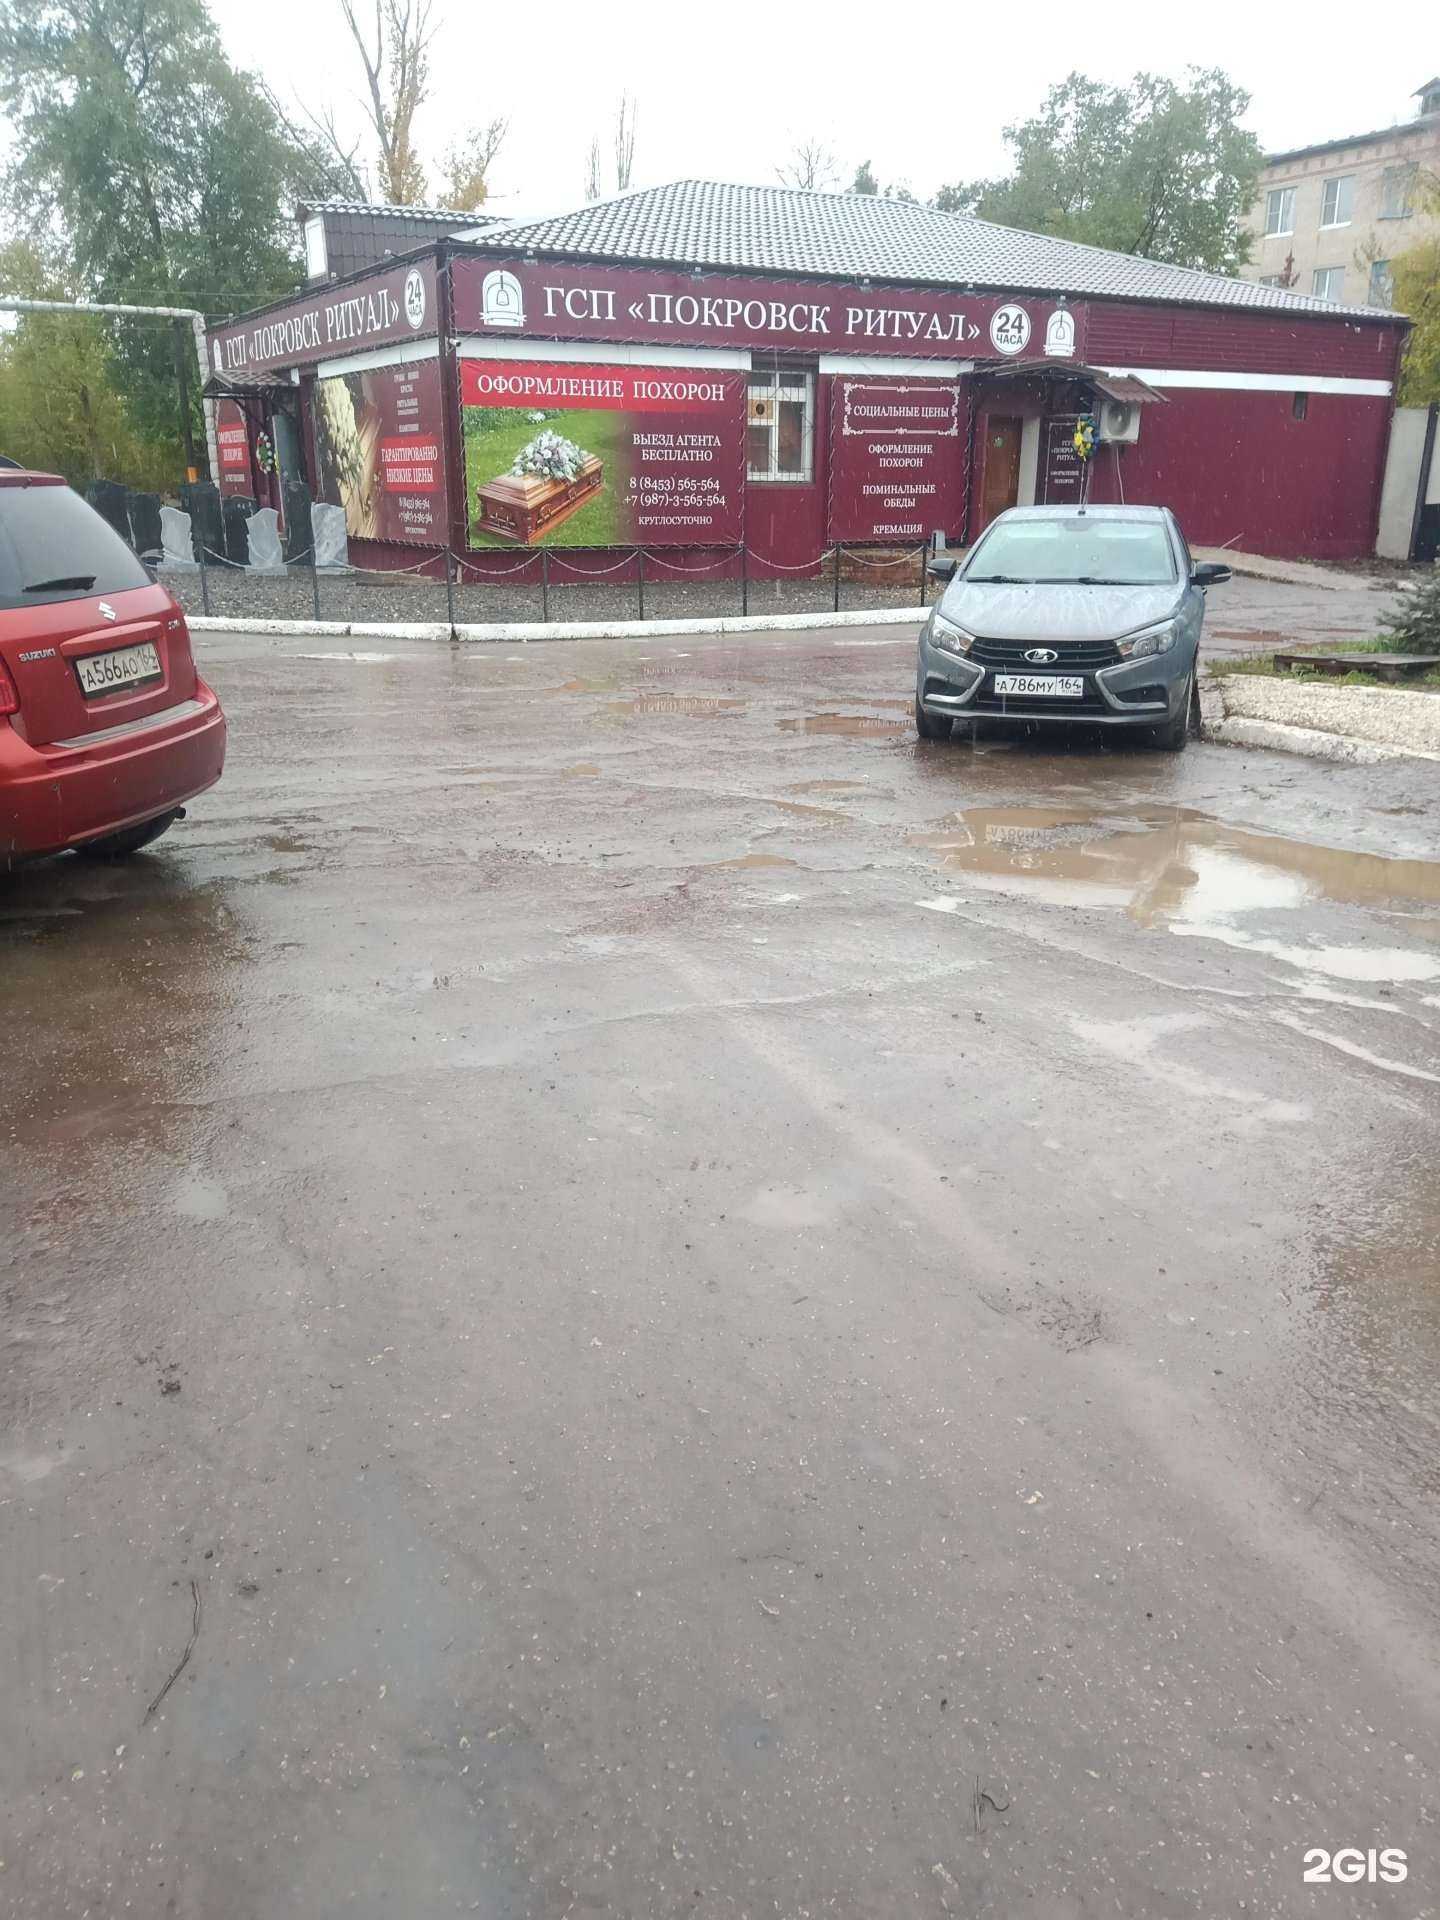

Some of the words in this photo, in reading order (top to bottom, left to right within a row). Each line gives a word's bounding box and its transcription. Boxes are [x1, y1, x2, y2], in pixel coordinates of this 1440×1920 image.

[407, 279, 421, 304] 24
[543, 287, 616, 320] ГСП
[628, 294, 830, 334] «ПОКРОВСК
[845, 307, 980, 341] РИТУАЛ»
[226, 335, 246, 368] ГСП
[249, 311, 321, 361] «ПОКРОВСК
[325, 289, 399, 343] РИТУАЛ»
[996, 311, 1024, 333] 24
[996, 333, 1023, 346] ЧАСА
[477, 374, 624, 398] ОФОРМЛЕНИЕ
[633, 381, 725, 401] ПОХОРОН
[853, 405, 919, 418] СОЦИАЛЬНЫЕ
[921, 406, 949, 418] ЦЕНЫ
[632, 433, 674, 447] ВЫЕЗД
[676, 434, 722, 447] АГЕНТА
[642, 449, 713, 461] БЕСПЛАТНО
[868, 444, 933, 455] ОФОРМЛЕНИЕ
[879, 458, 923, 468] ПОХОРОН
[629, 477, 637, 489] 8
[639, 476, 675, 491] (8453)
[677, 477, 720, 491] 565-564
[862, 484, 936, 495] ПОМИНАЛЬНЫЕ
[624, 495, 638, 507] +7
[640, 493, 726, 507] (987)-3-565-564
[883, 498, 916, 508] ОБЕДЫ
[638, 515, 713, 525] КРУГЛОСУТОЧНО
[873, 523, 923, 534] КРЕМАЦИЯ
[18, 648, 56, 662] SUZUKI
